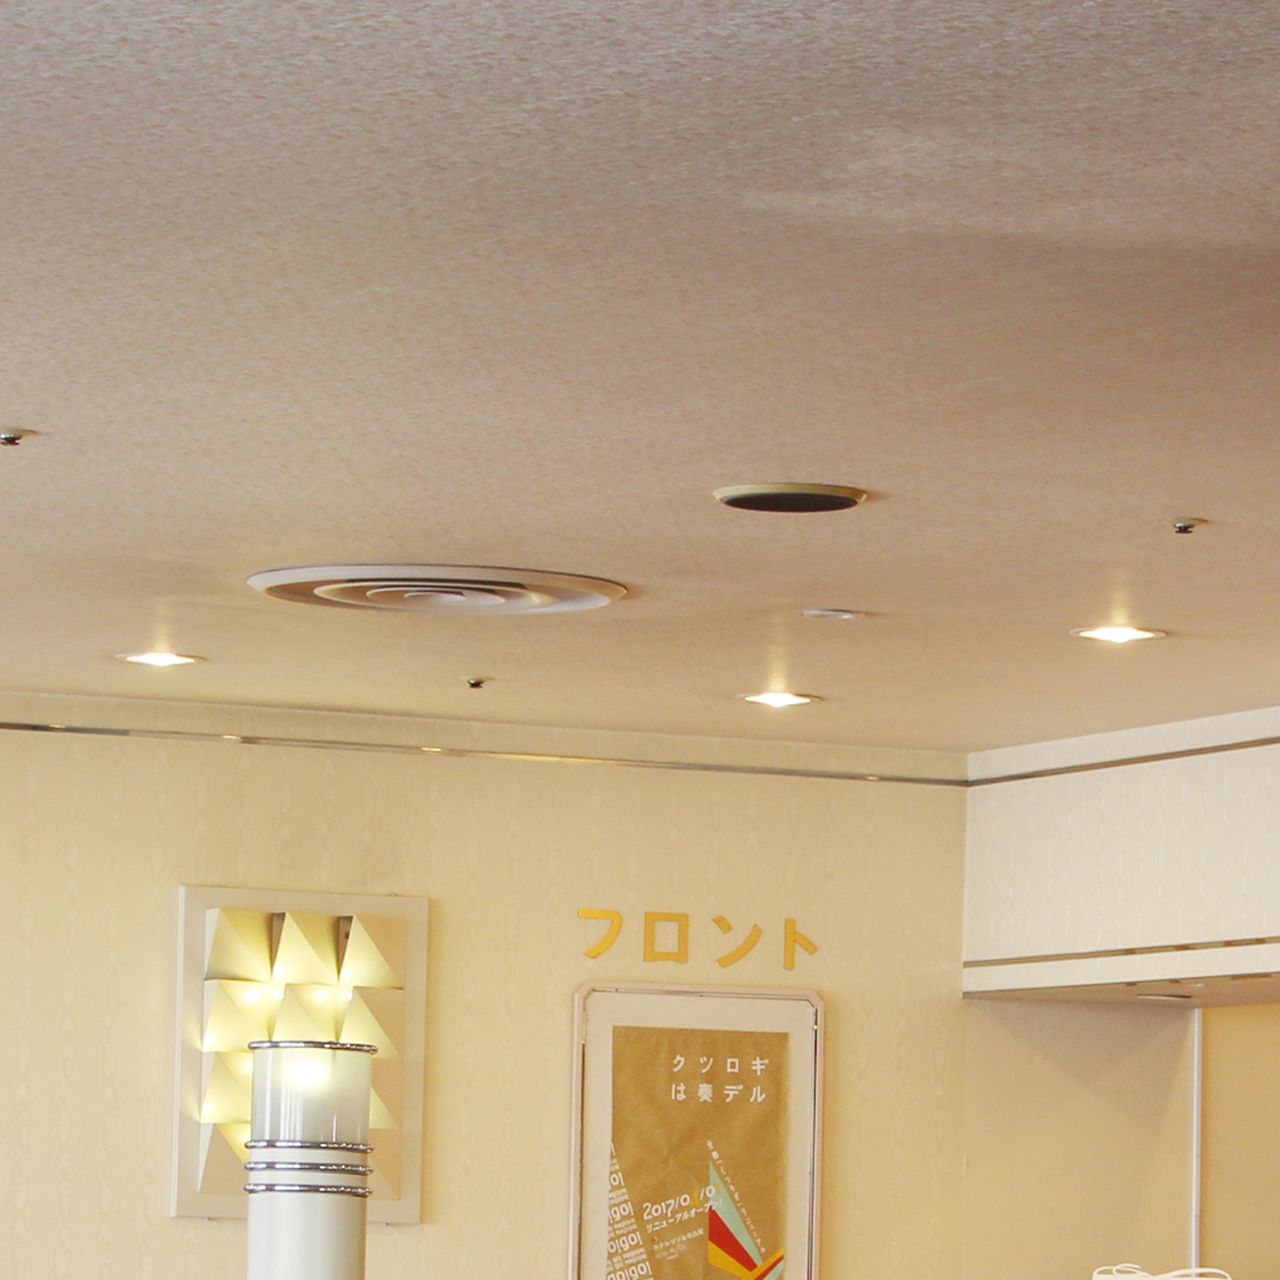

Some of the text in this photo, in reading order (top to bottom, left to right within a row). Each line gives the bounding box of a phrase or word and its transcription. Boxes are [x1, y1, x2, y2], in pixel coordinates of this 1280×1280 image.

[577, 908, 818, 970] フロント
[673, 1054, 769, 1076] クツロギ
